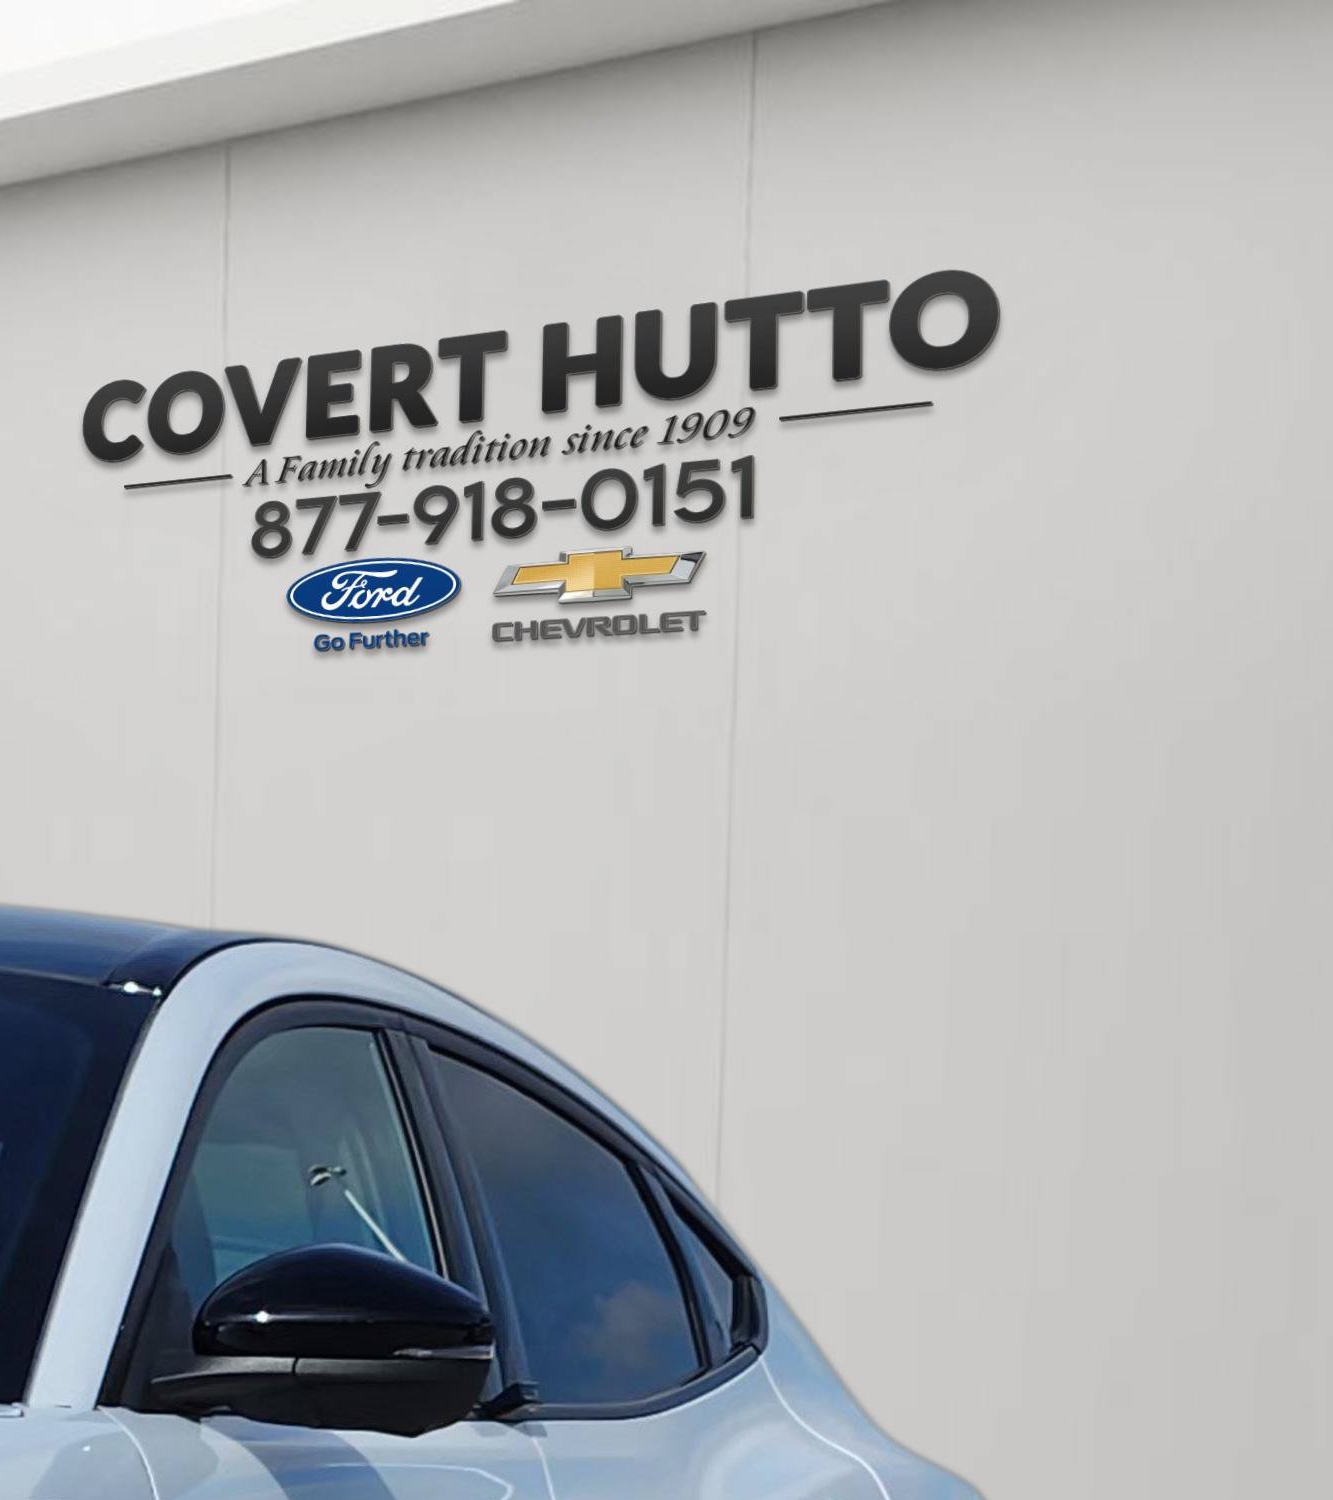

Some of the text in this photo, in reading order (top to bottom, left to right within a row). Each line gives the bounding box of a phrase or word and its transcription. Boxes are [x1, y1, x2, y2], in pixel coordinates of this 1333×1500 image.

[82, 269, 1001, 464] COVERT HUTTO
[242, 406, 757, 489] A Family tradition since 1909
[250, 454, 756, 559] 877-918-0151
[320, 569, 423, 611] Ford
[313, 628, 430, 653] Go Further
[491, 609, 708, 644] CHEVROLET
